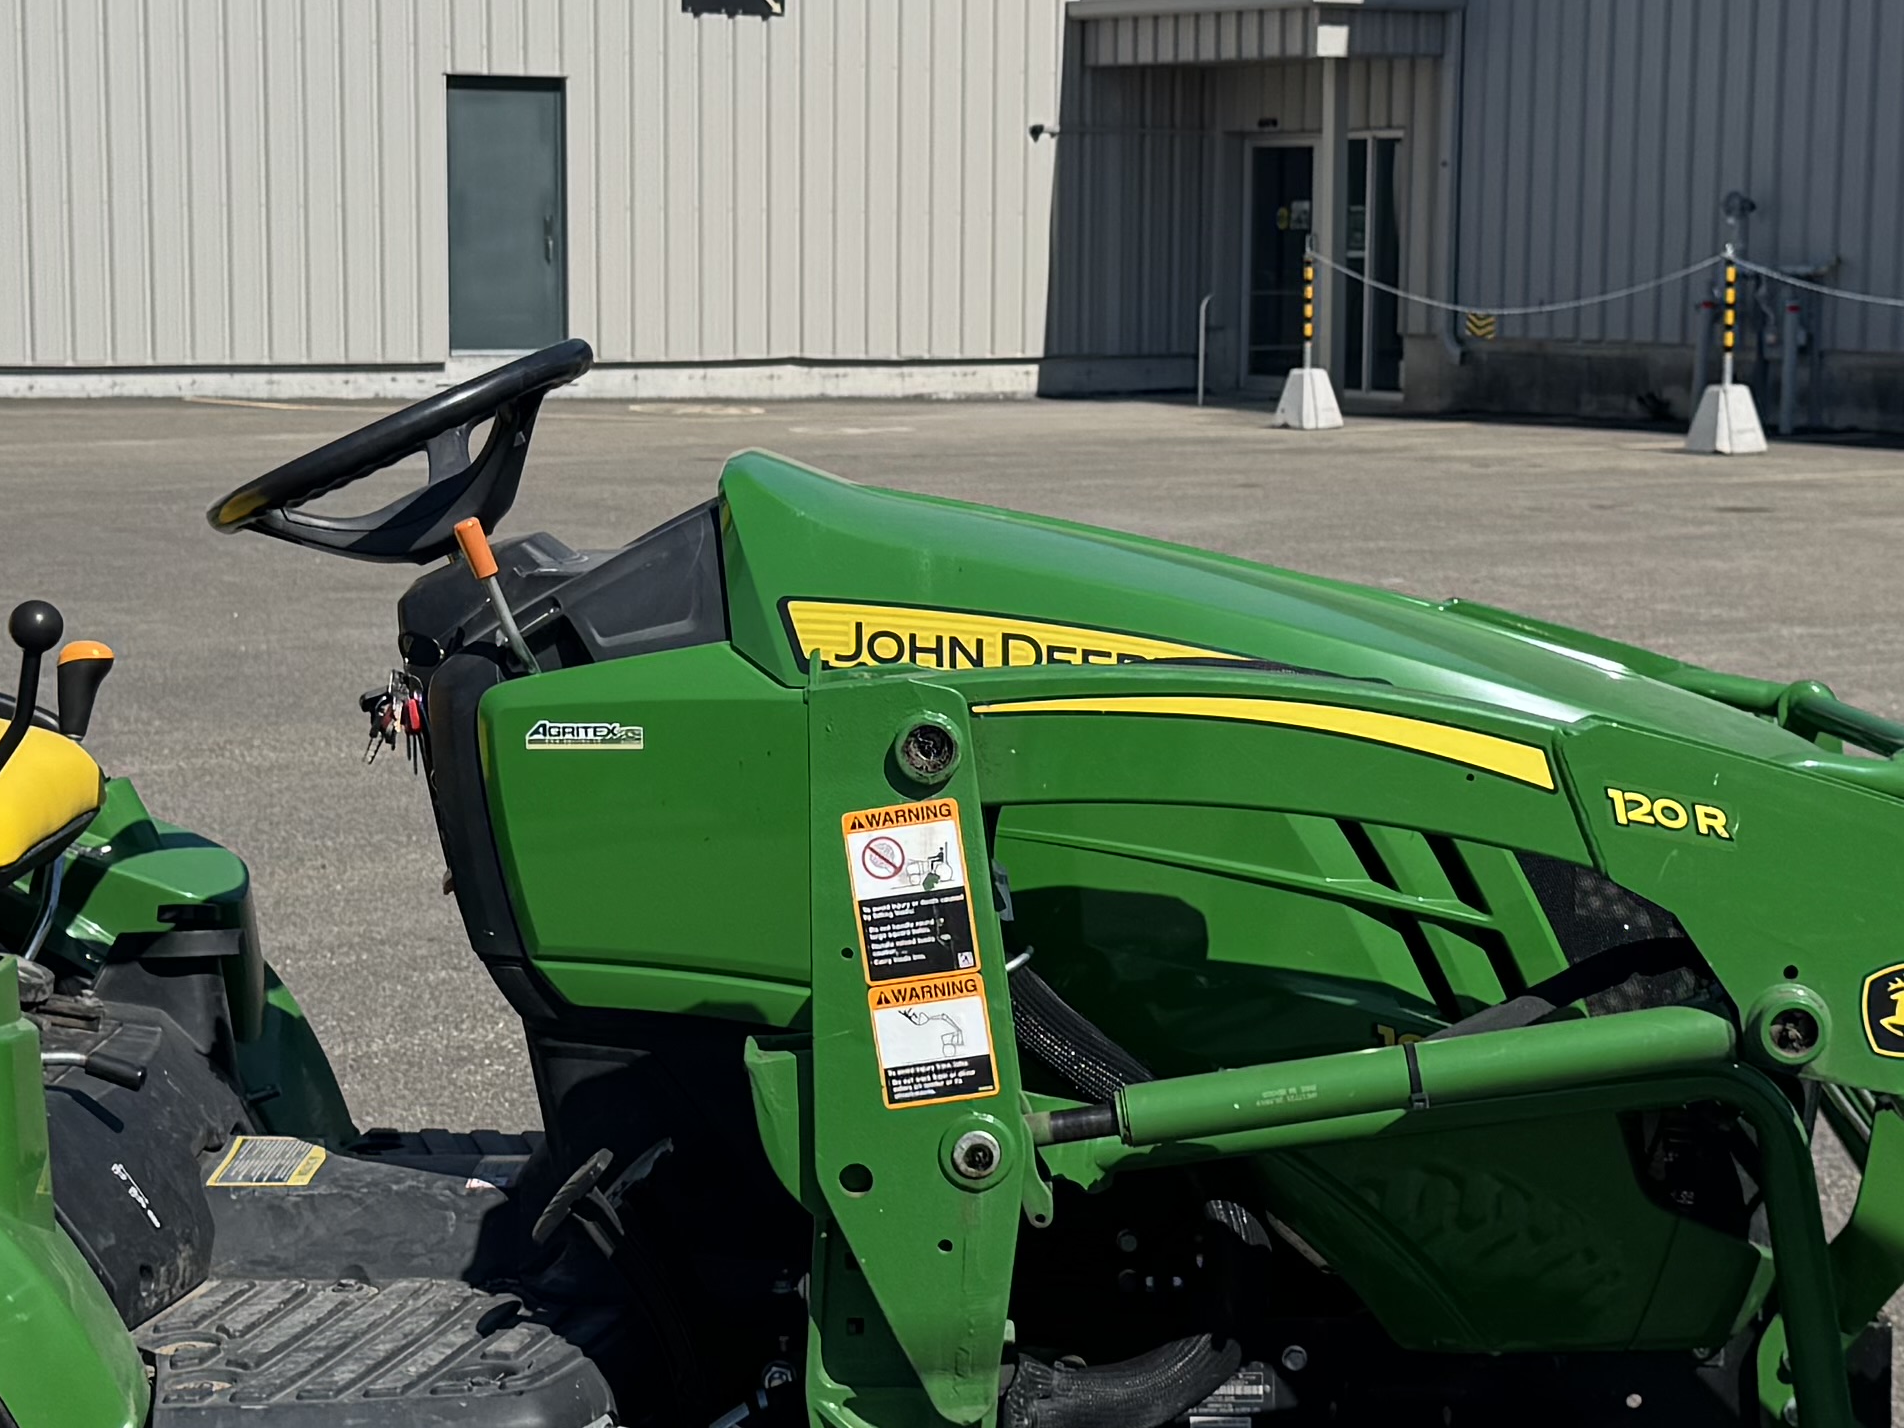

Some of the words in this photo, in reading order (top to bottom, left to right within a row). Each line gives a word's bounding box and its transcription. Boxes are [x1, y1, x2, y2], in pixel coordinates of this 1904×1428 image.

[834, 621, 984, 669] JOHN
[529, 723, 618, 738] AGRITEX
[865, 803, 952, 828] WARNING
[1605, 786, 1689, 830] 120
[1692, 803, 1733, 840] R
[892, 979, 977, 1003] WARNING
